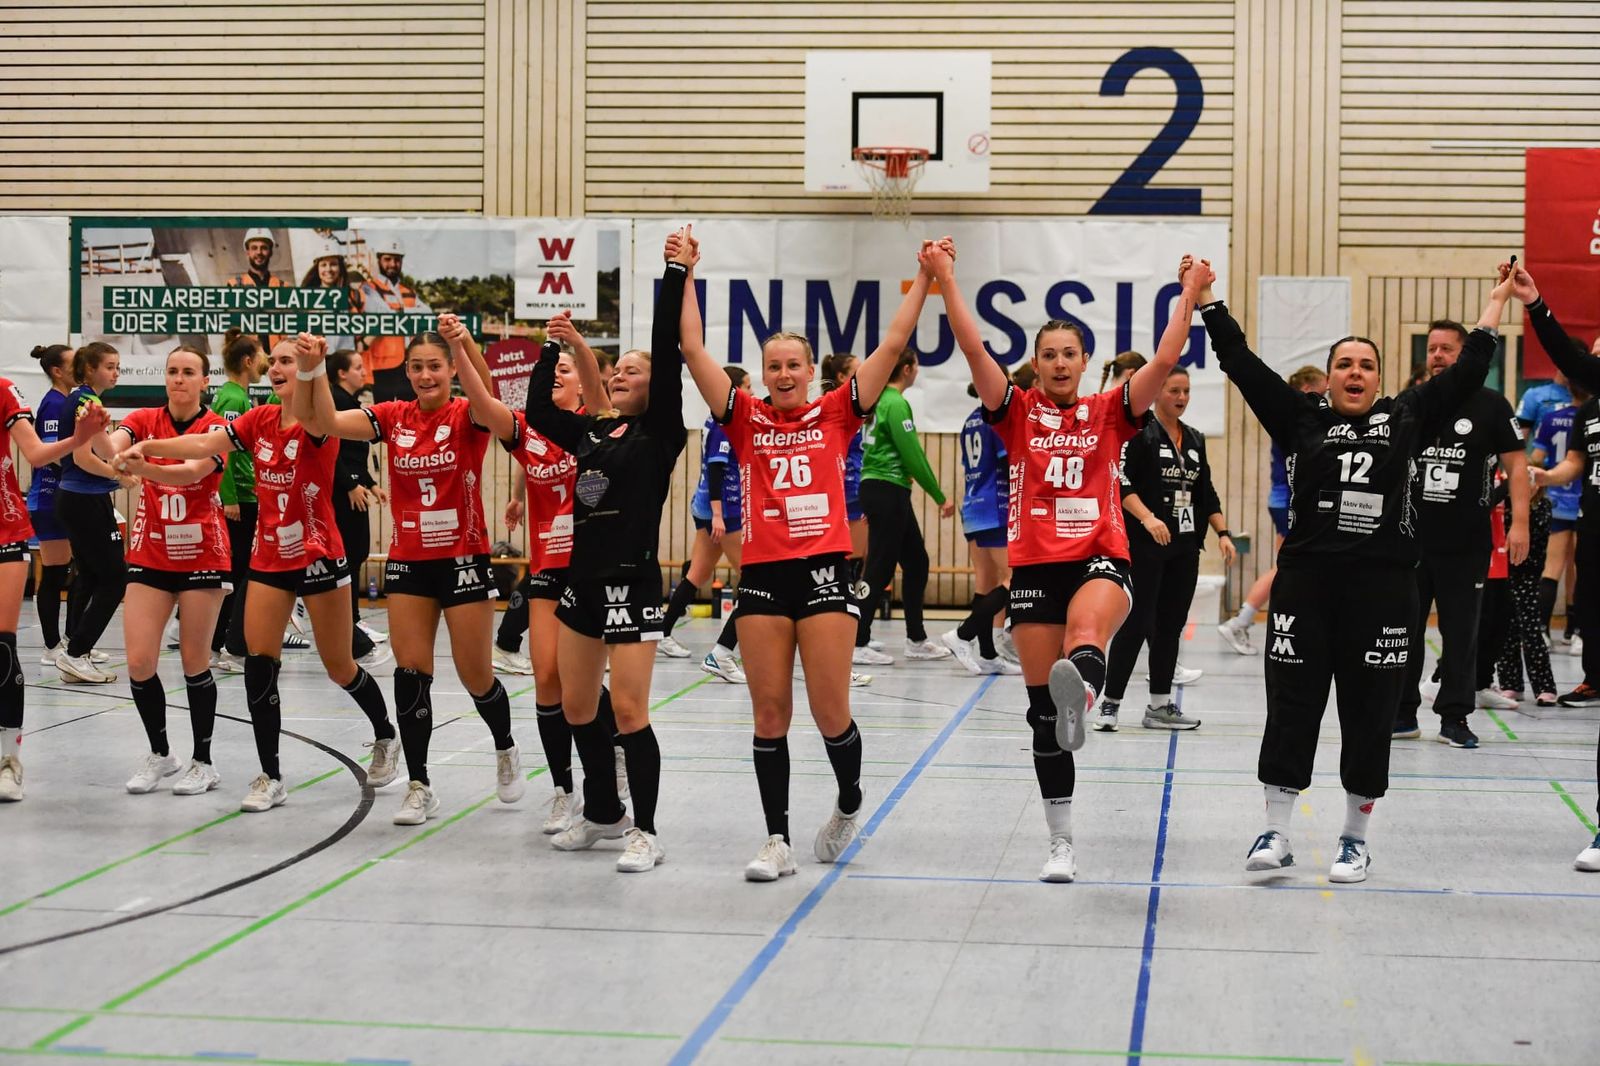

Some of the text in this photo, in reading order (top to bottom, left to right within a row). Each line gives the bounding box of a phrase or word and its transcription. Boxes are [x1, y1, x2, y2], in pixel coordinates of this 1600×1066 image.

[1089, 46, 1204, 215] 2
[538, 237, 575, 261] W
[538, 272, 574, 294] M
[112, 287, 342, 309] EIN ARBEITSPLATZ?
[112, 313, 477, 335] ODER EINE NEUE PERSPEKTI!
[497, 350, 525, 363] Jetzt
[1036, 402, 1060, 415] Kempa
[753, 421, 823, 447] adensio
[393, 442, 456, 470] adensio
[769, 454, 813, 490] 26
[1044, 456, 1084, 490] 48
[1337, 451, 1374, 484] 12
[1430, 465, 1443, 482] C
[418, 477, 437, 507] 5
[551, 484, 567, 505] 7
[158, 493, 187, 522] 10
[1180, 508, 1192, 525] A
[306, 560, 329, 577] M
[457, 568, 480, 587] M
[810, 565, 835, 586] W
[605, 585, 629, 603] W
[1010, 589, 1046, 600] KEIDEL
[606, 608, 632, 626] M
[1272, 612, 1296, 632] W
[1382, 626, 1407, 636] Kempa
[1271, 636, 1296, 656] M
[1364, 650, 1408, 665] CAB
